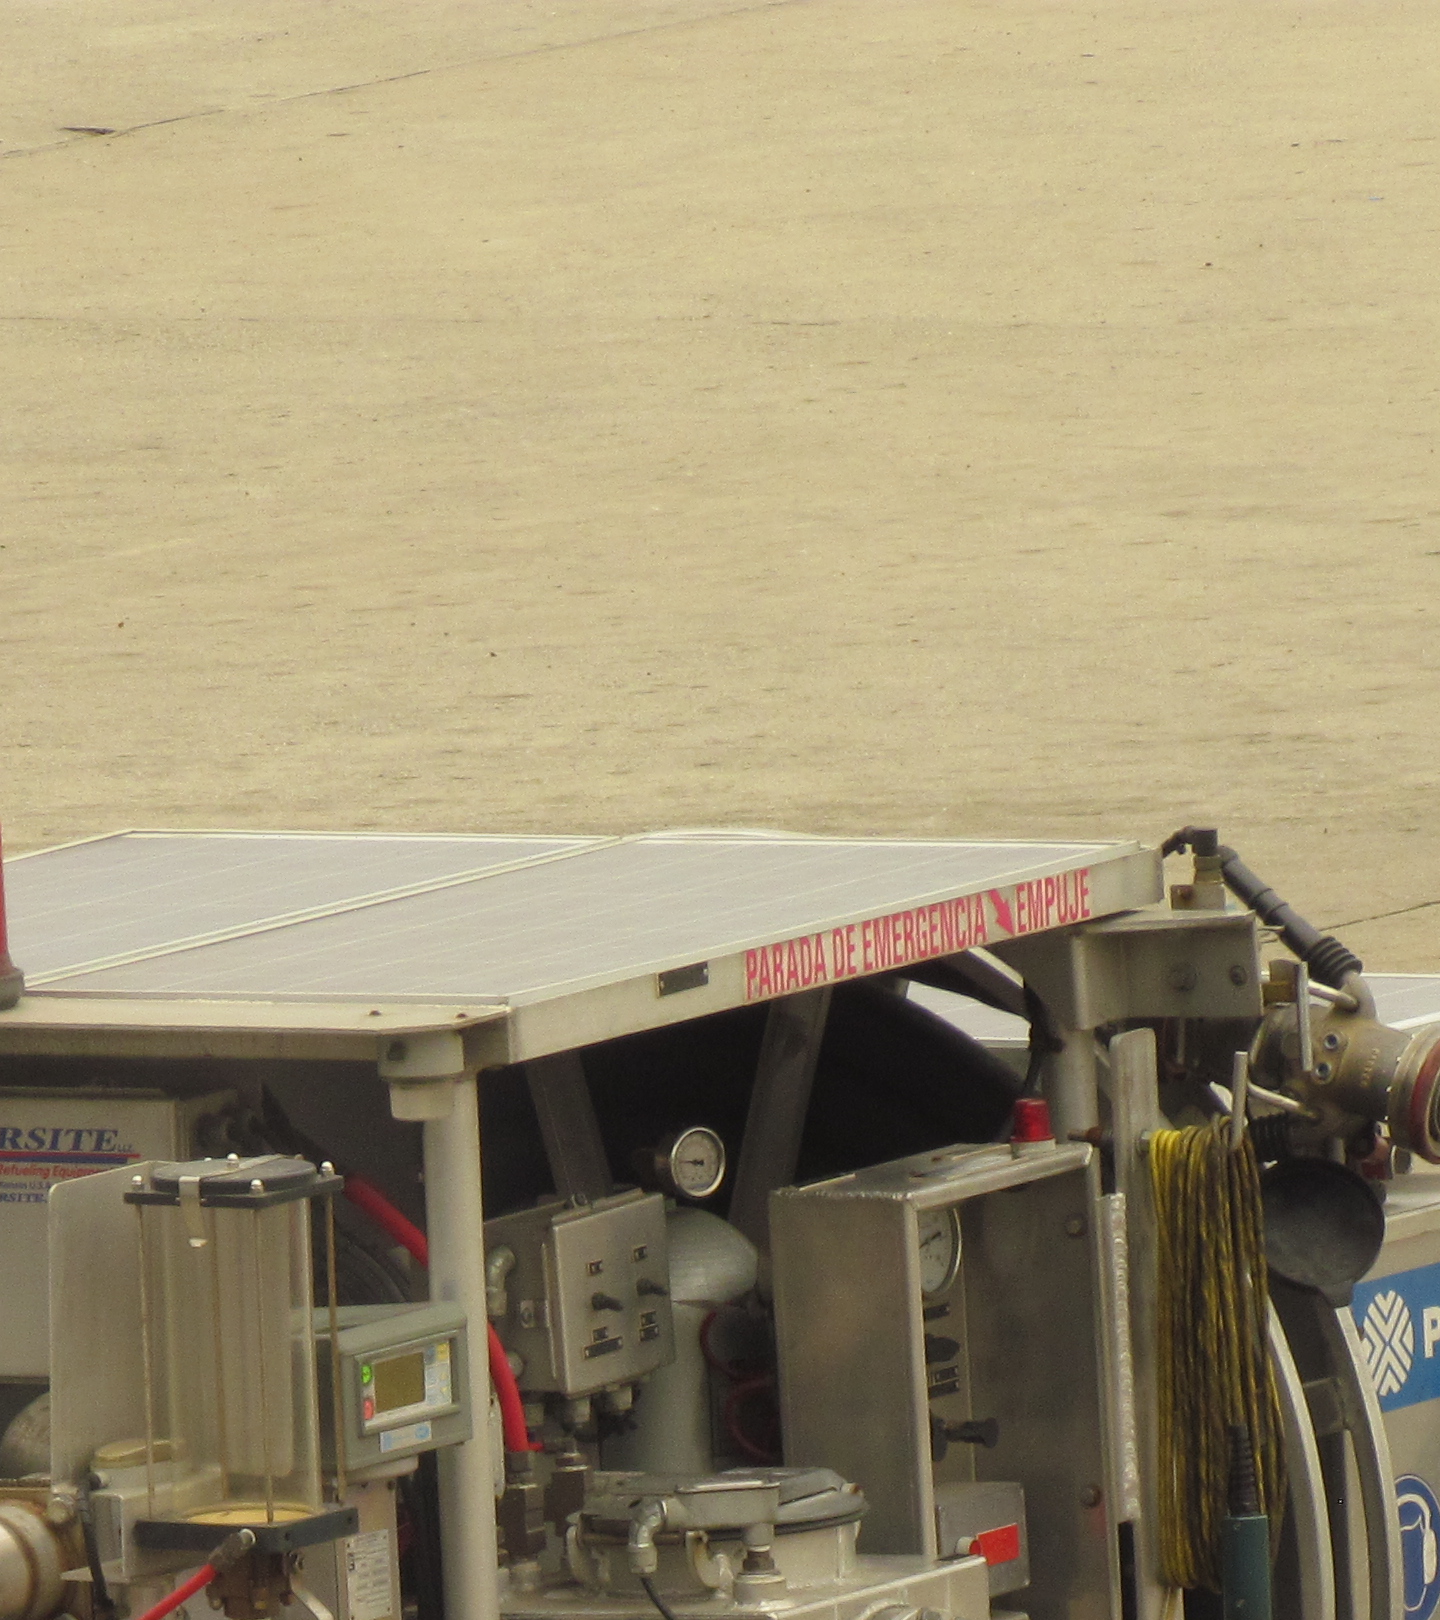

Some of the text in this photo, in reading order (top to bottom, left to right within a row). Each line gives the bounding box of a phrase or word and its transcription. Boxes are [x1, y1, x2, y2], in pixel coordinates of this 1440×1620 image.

[744, 868, 1091, 1000] PARADA DE EMERGENCIA EMPUJE
